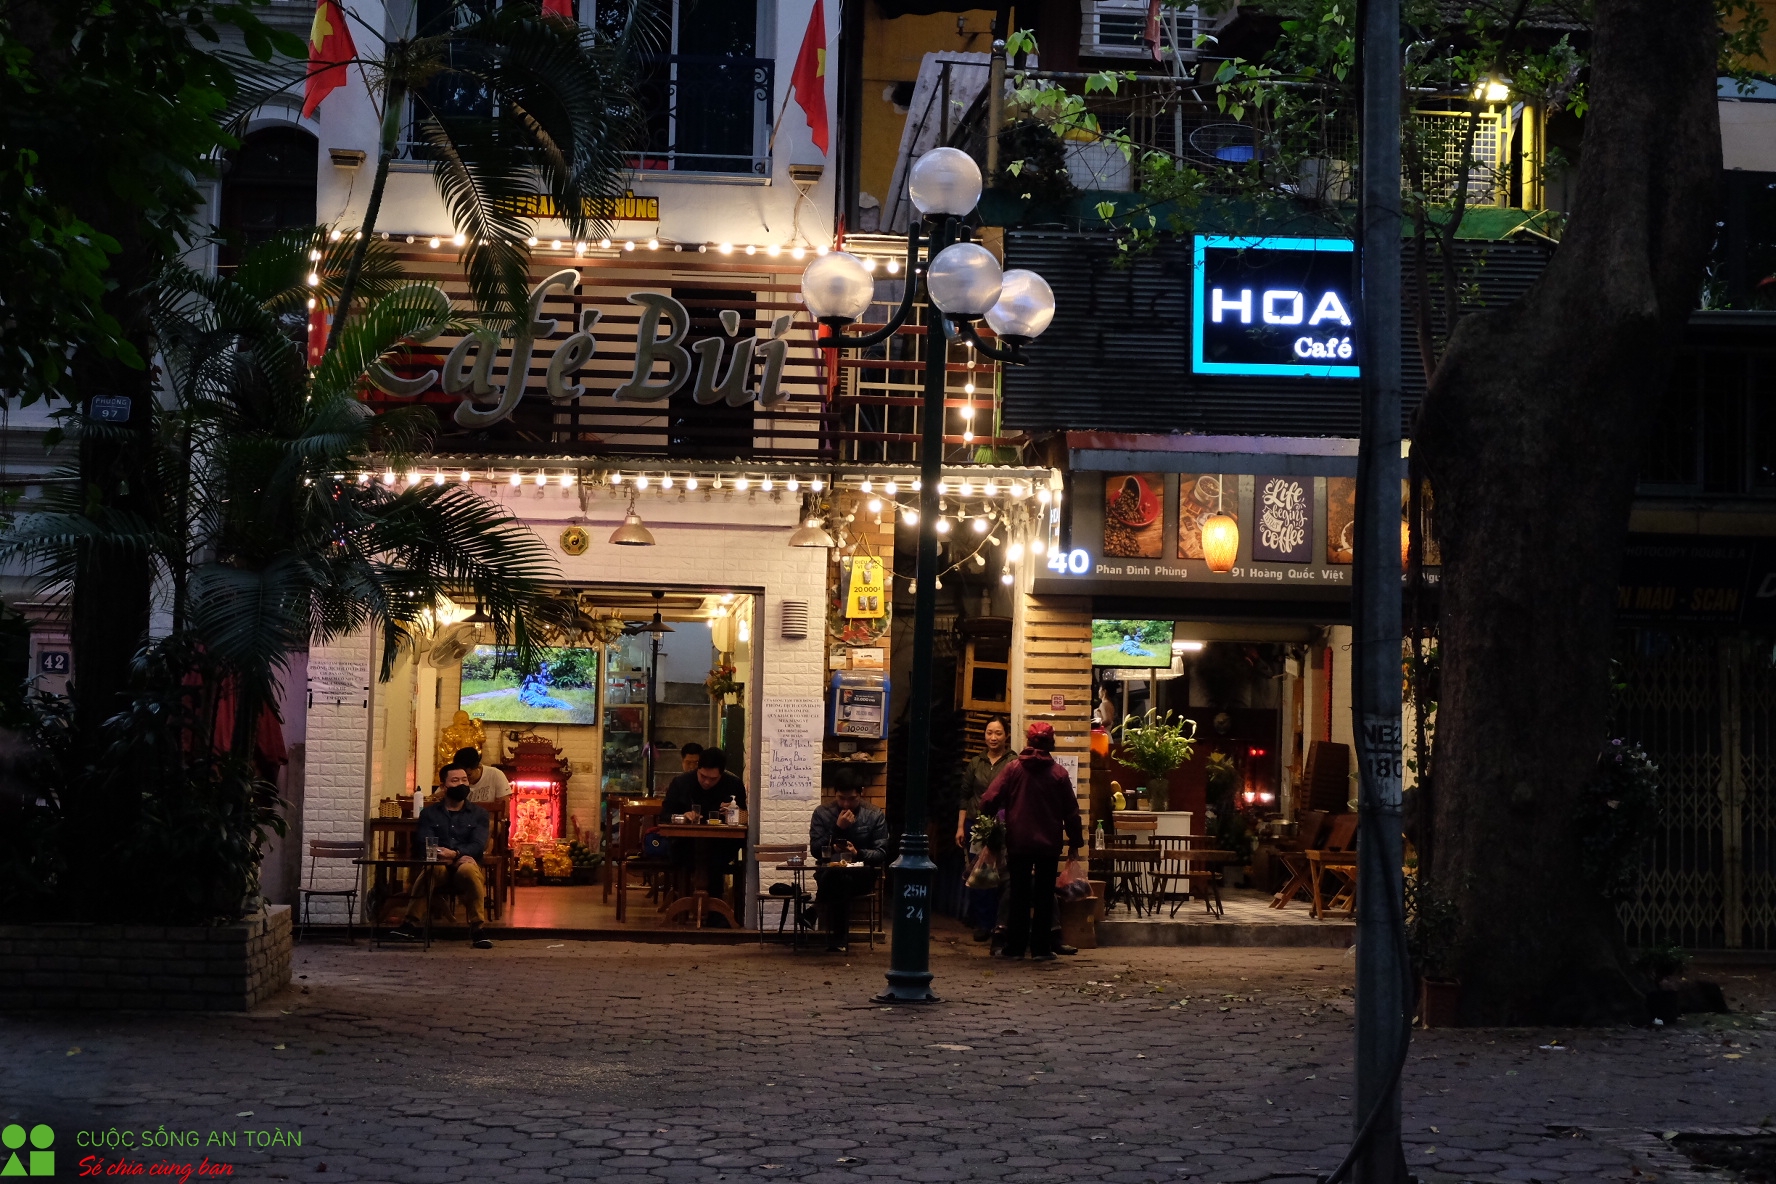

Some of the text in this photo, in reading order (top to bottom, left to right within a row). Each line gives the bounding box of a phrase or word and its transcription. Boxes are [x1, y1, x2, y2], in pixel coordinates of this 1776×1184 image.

[1212, 288, 1351, 326] HOA
[365, 268, 793, 429] Café Bùi
[1294, 337, 1352, 358] Café
[102, 410, 118, 418] 97
[1263, 480, 1303, 510] Life
[1272, 504, 1308, 527] begins
[1262, 524, 1304, 553] coffee
[1048, 550, 1090, 575] 40
[1096, 565, 1122, 574] Phan
[1126, 565, 1150, 575] Đình
[1155, 566, 1187, 578] Phùng
[1232, 567, 1245, 578] 91
[1250, 569, 1283, 580] Hoàng
[1288, 567, 1314, 579] Quốc
[1322, 570, 1344, 582] Việt
[1690, 587, 1740, 612] SCAN
[44, 654, 64, 669] 42
